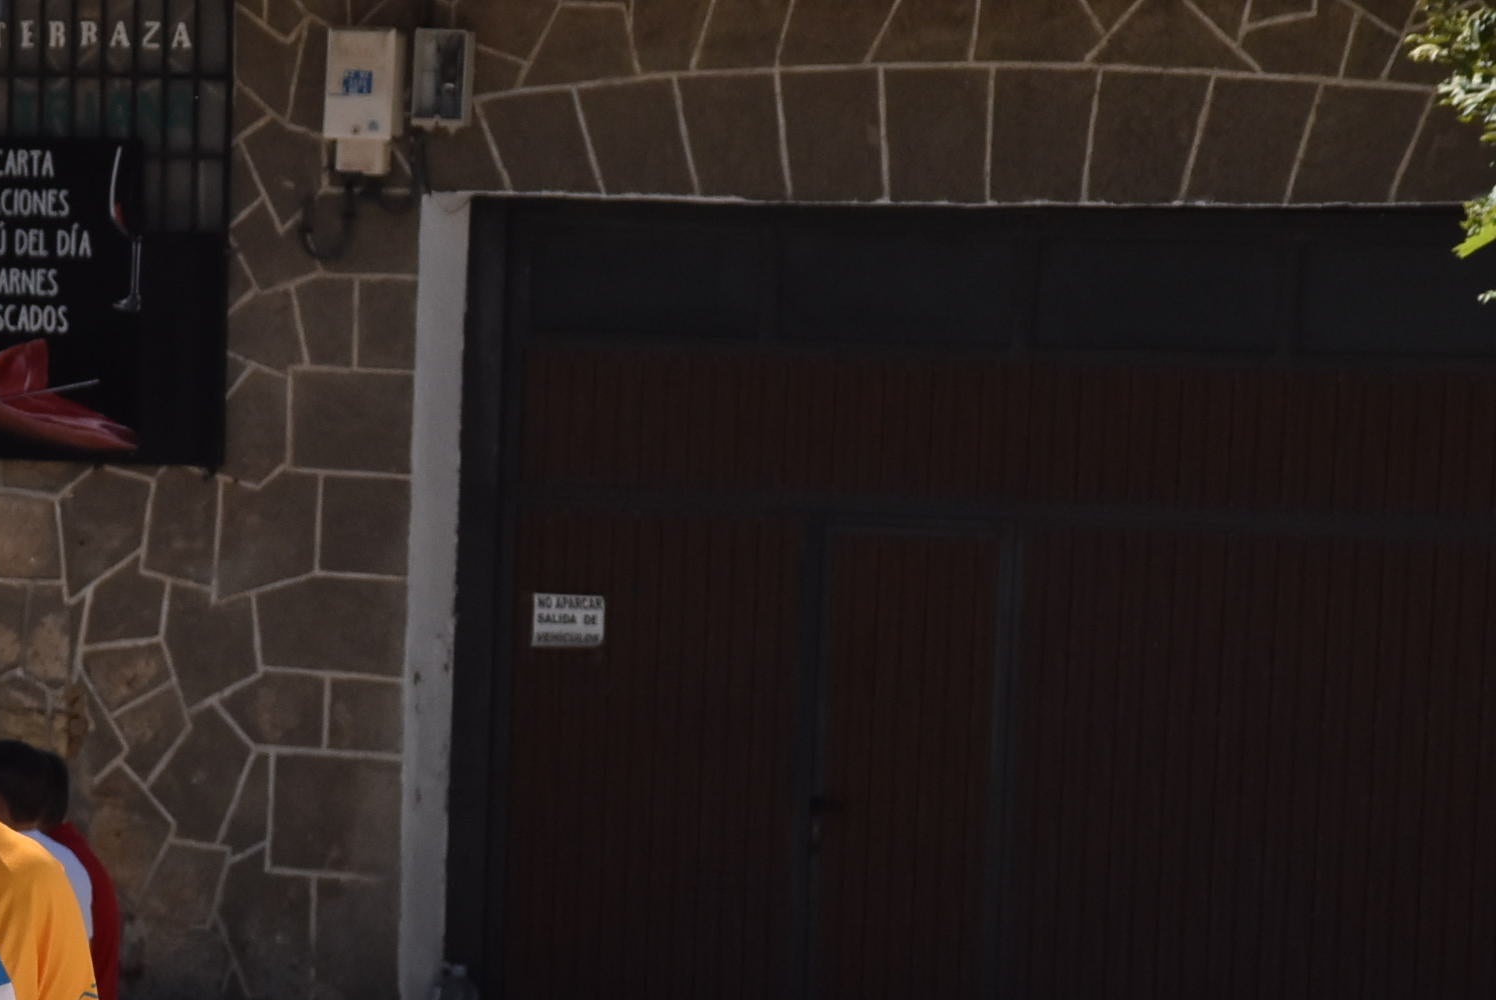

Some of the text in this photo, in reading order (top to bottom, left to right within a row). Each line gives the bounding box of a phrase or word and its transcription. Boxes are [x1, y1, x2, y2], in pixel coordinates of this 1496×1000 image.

[14, 228, 49, 257] DEL
[56, 222, 92, 258] DÍA
[537, 597, 553, 609] NO
[537, 613, 597, 625] SALIDA DE
